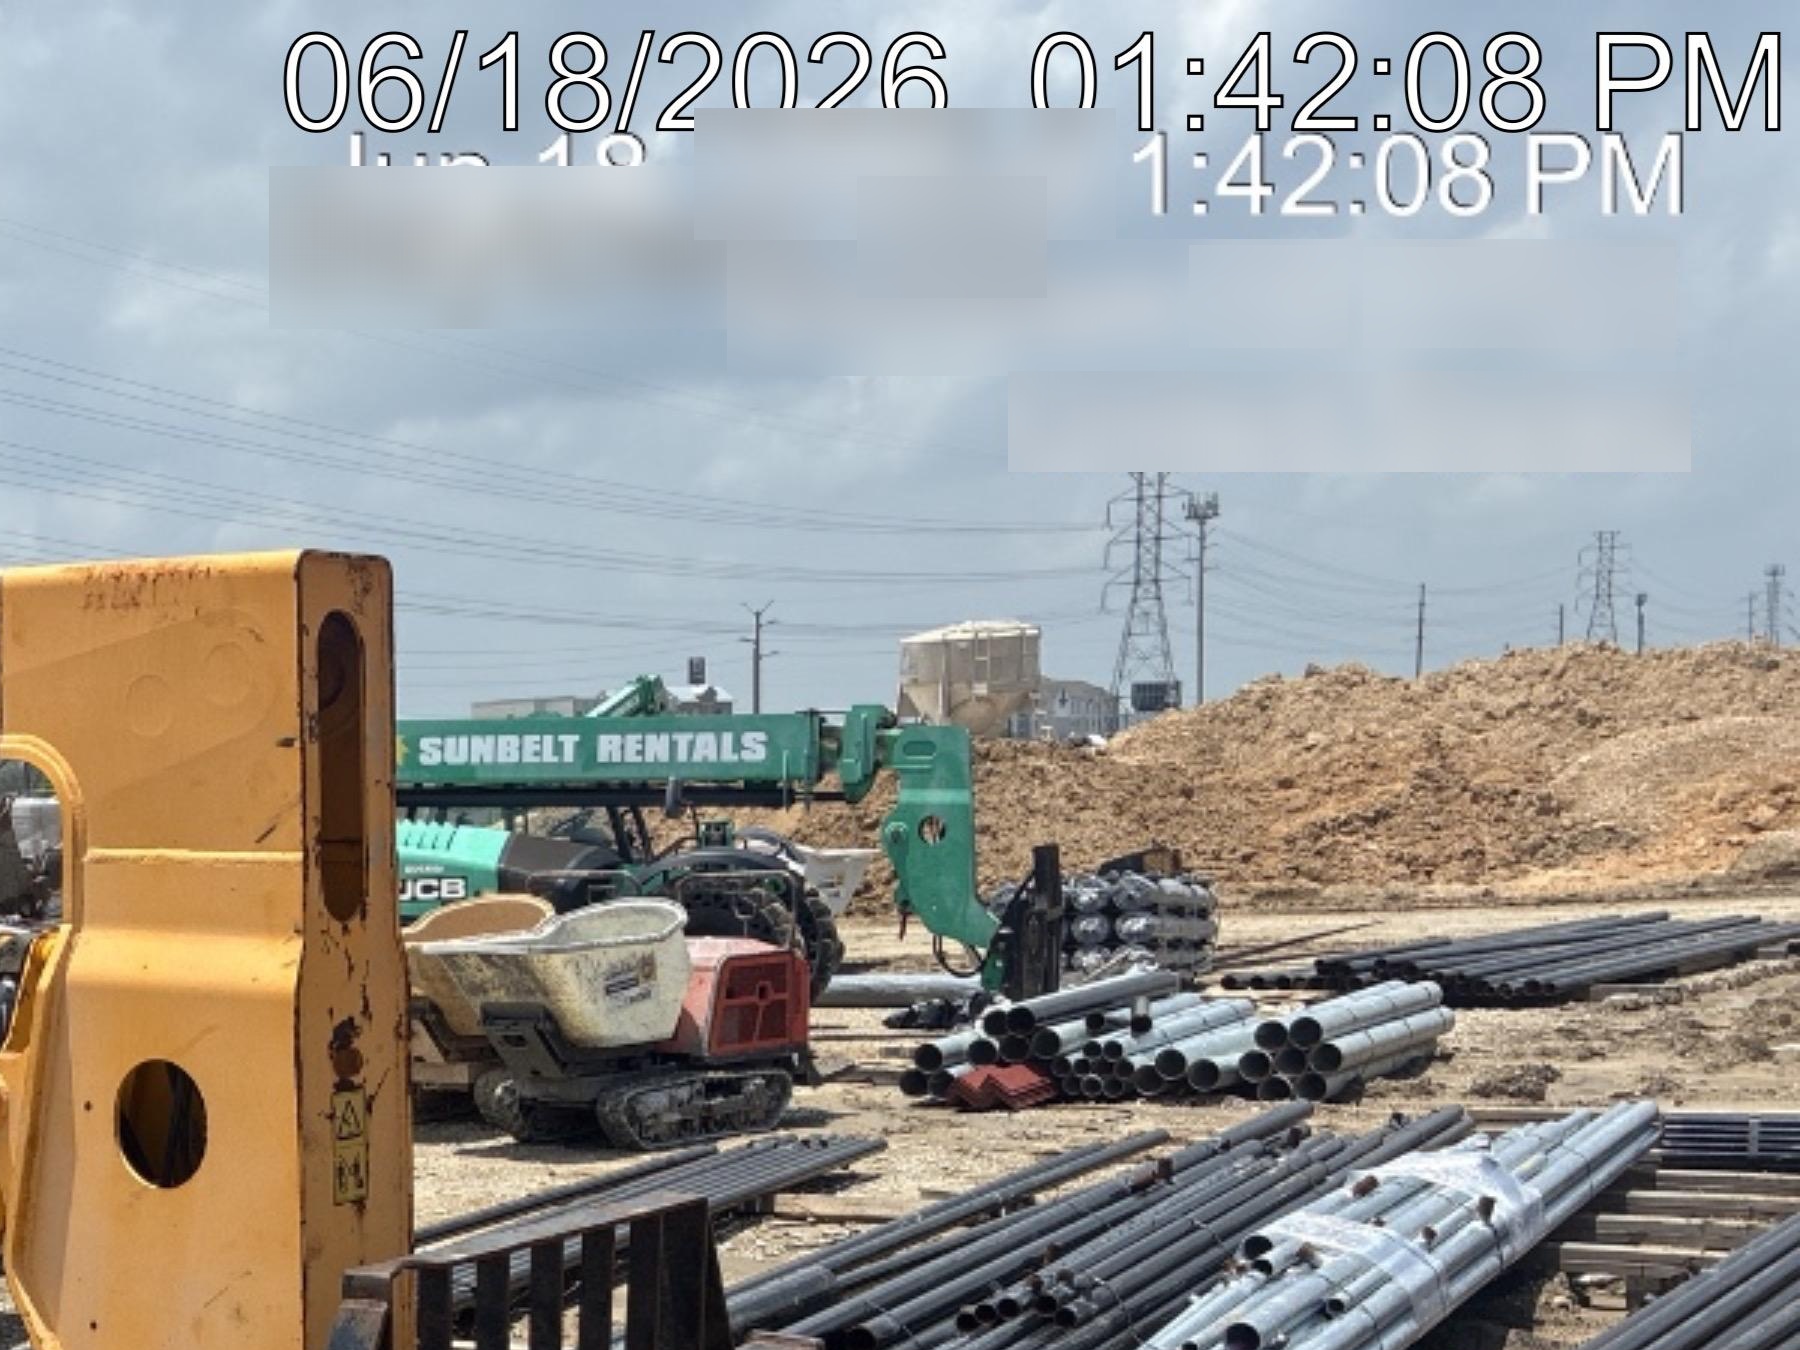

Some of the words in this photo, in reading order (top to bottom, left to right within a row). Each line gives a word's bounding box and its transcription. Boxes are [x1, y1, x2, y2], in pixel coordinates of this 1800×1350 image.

[418, 733, 581, 766] SUNBELT
[596, 731, 769, 763] RENTALS
[398, 877, 466, 901] JCB
